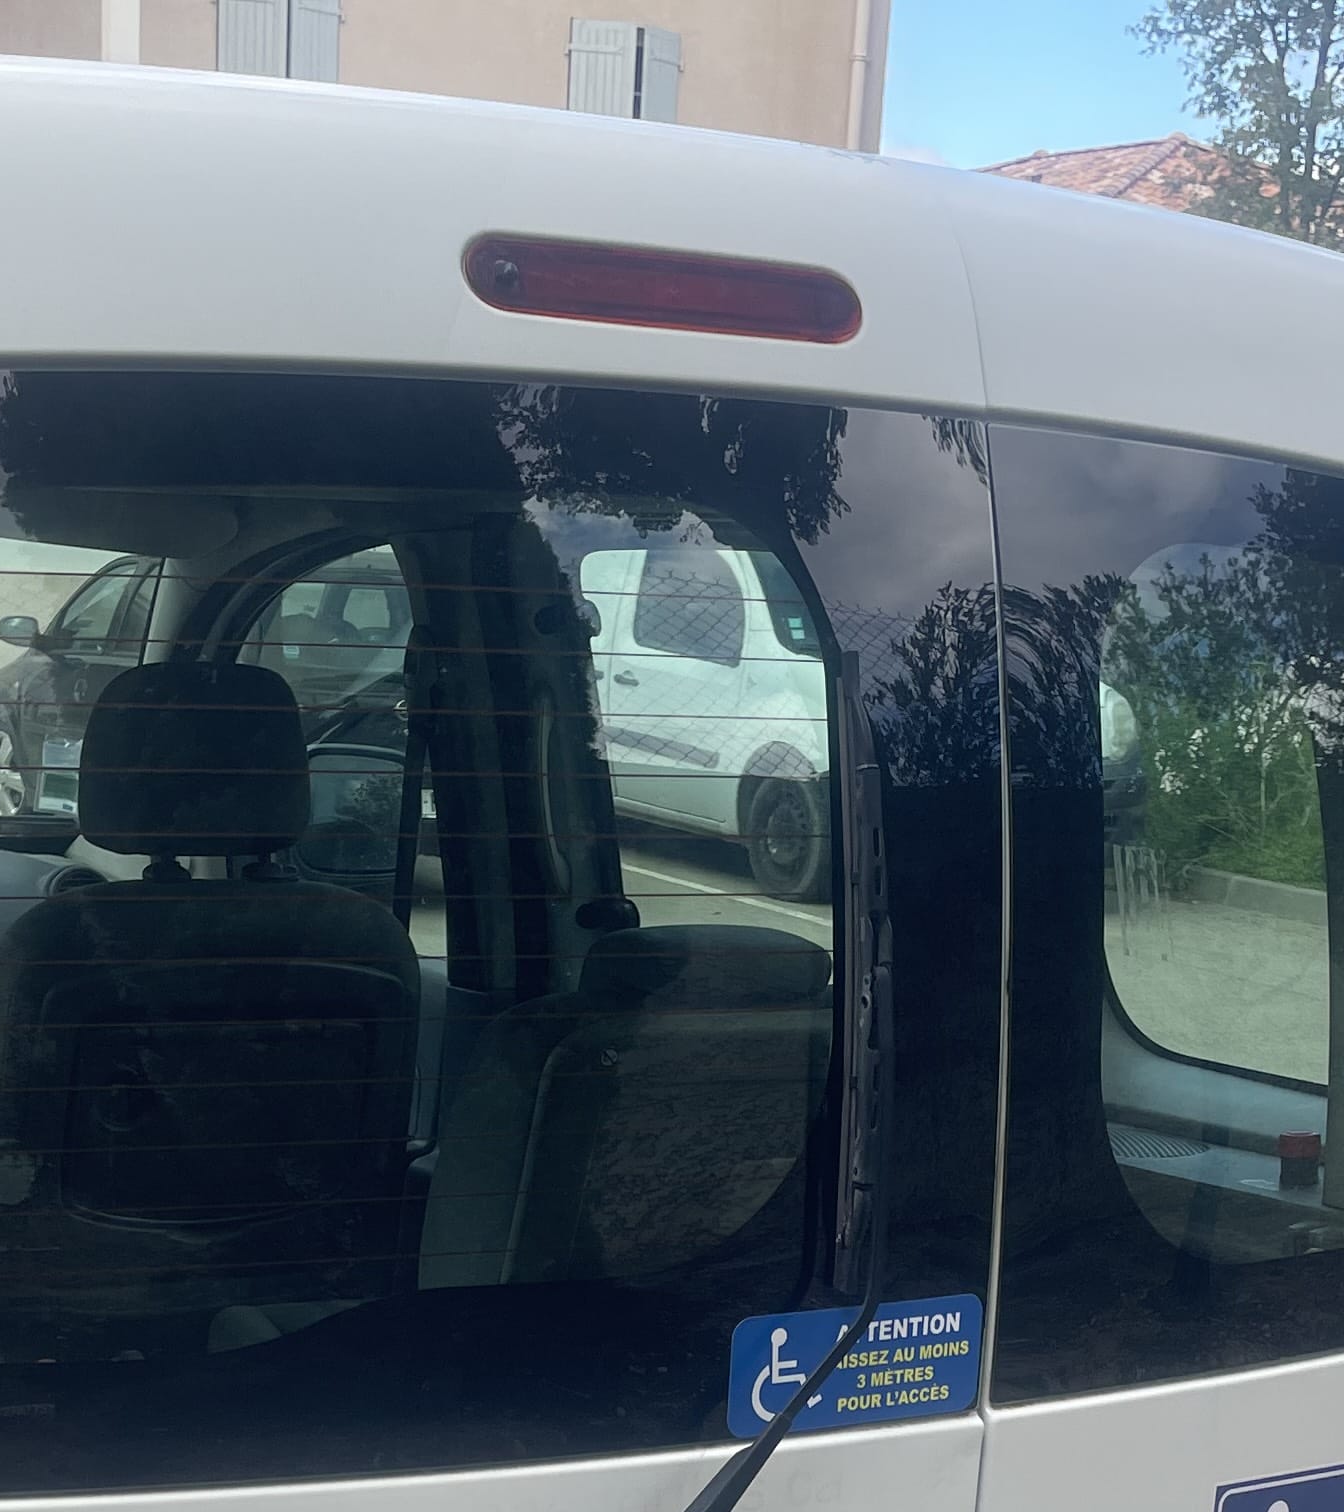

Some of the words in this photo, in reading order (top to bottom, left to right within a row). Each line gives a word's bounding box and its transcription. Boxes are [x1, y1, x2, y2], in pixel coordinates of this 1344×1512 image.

[893, 1346, 914, 1363] AU
[919, 1340, 969, 1359] MOINS
[856, 1373, 865, 1389] 3
[871, 1366, 934, 1388] MÈTRES
[838, 1393, 881, 1413] POUR
[886, 1384, 949, 1407] L'ACCÈS
